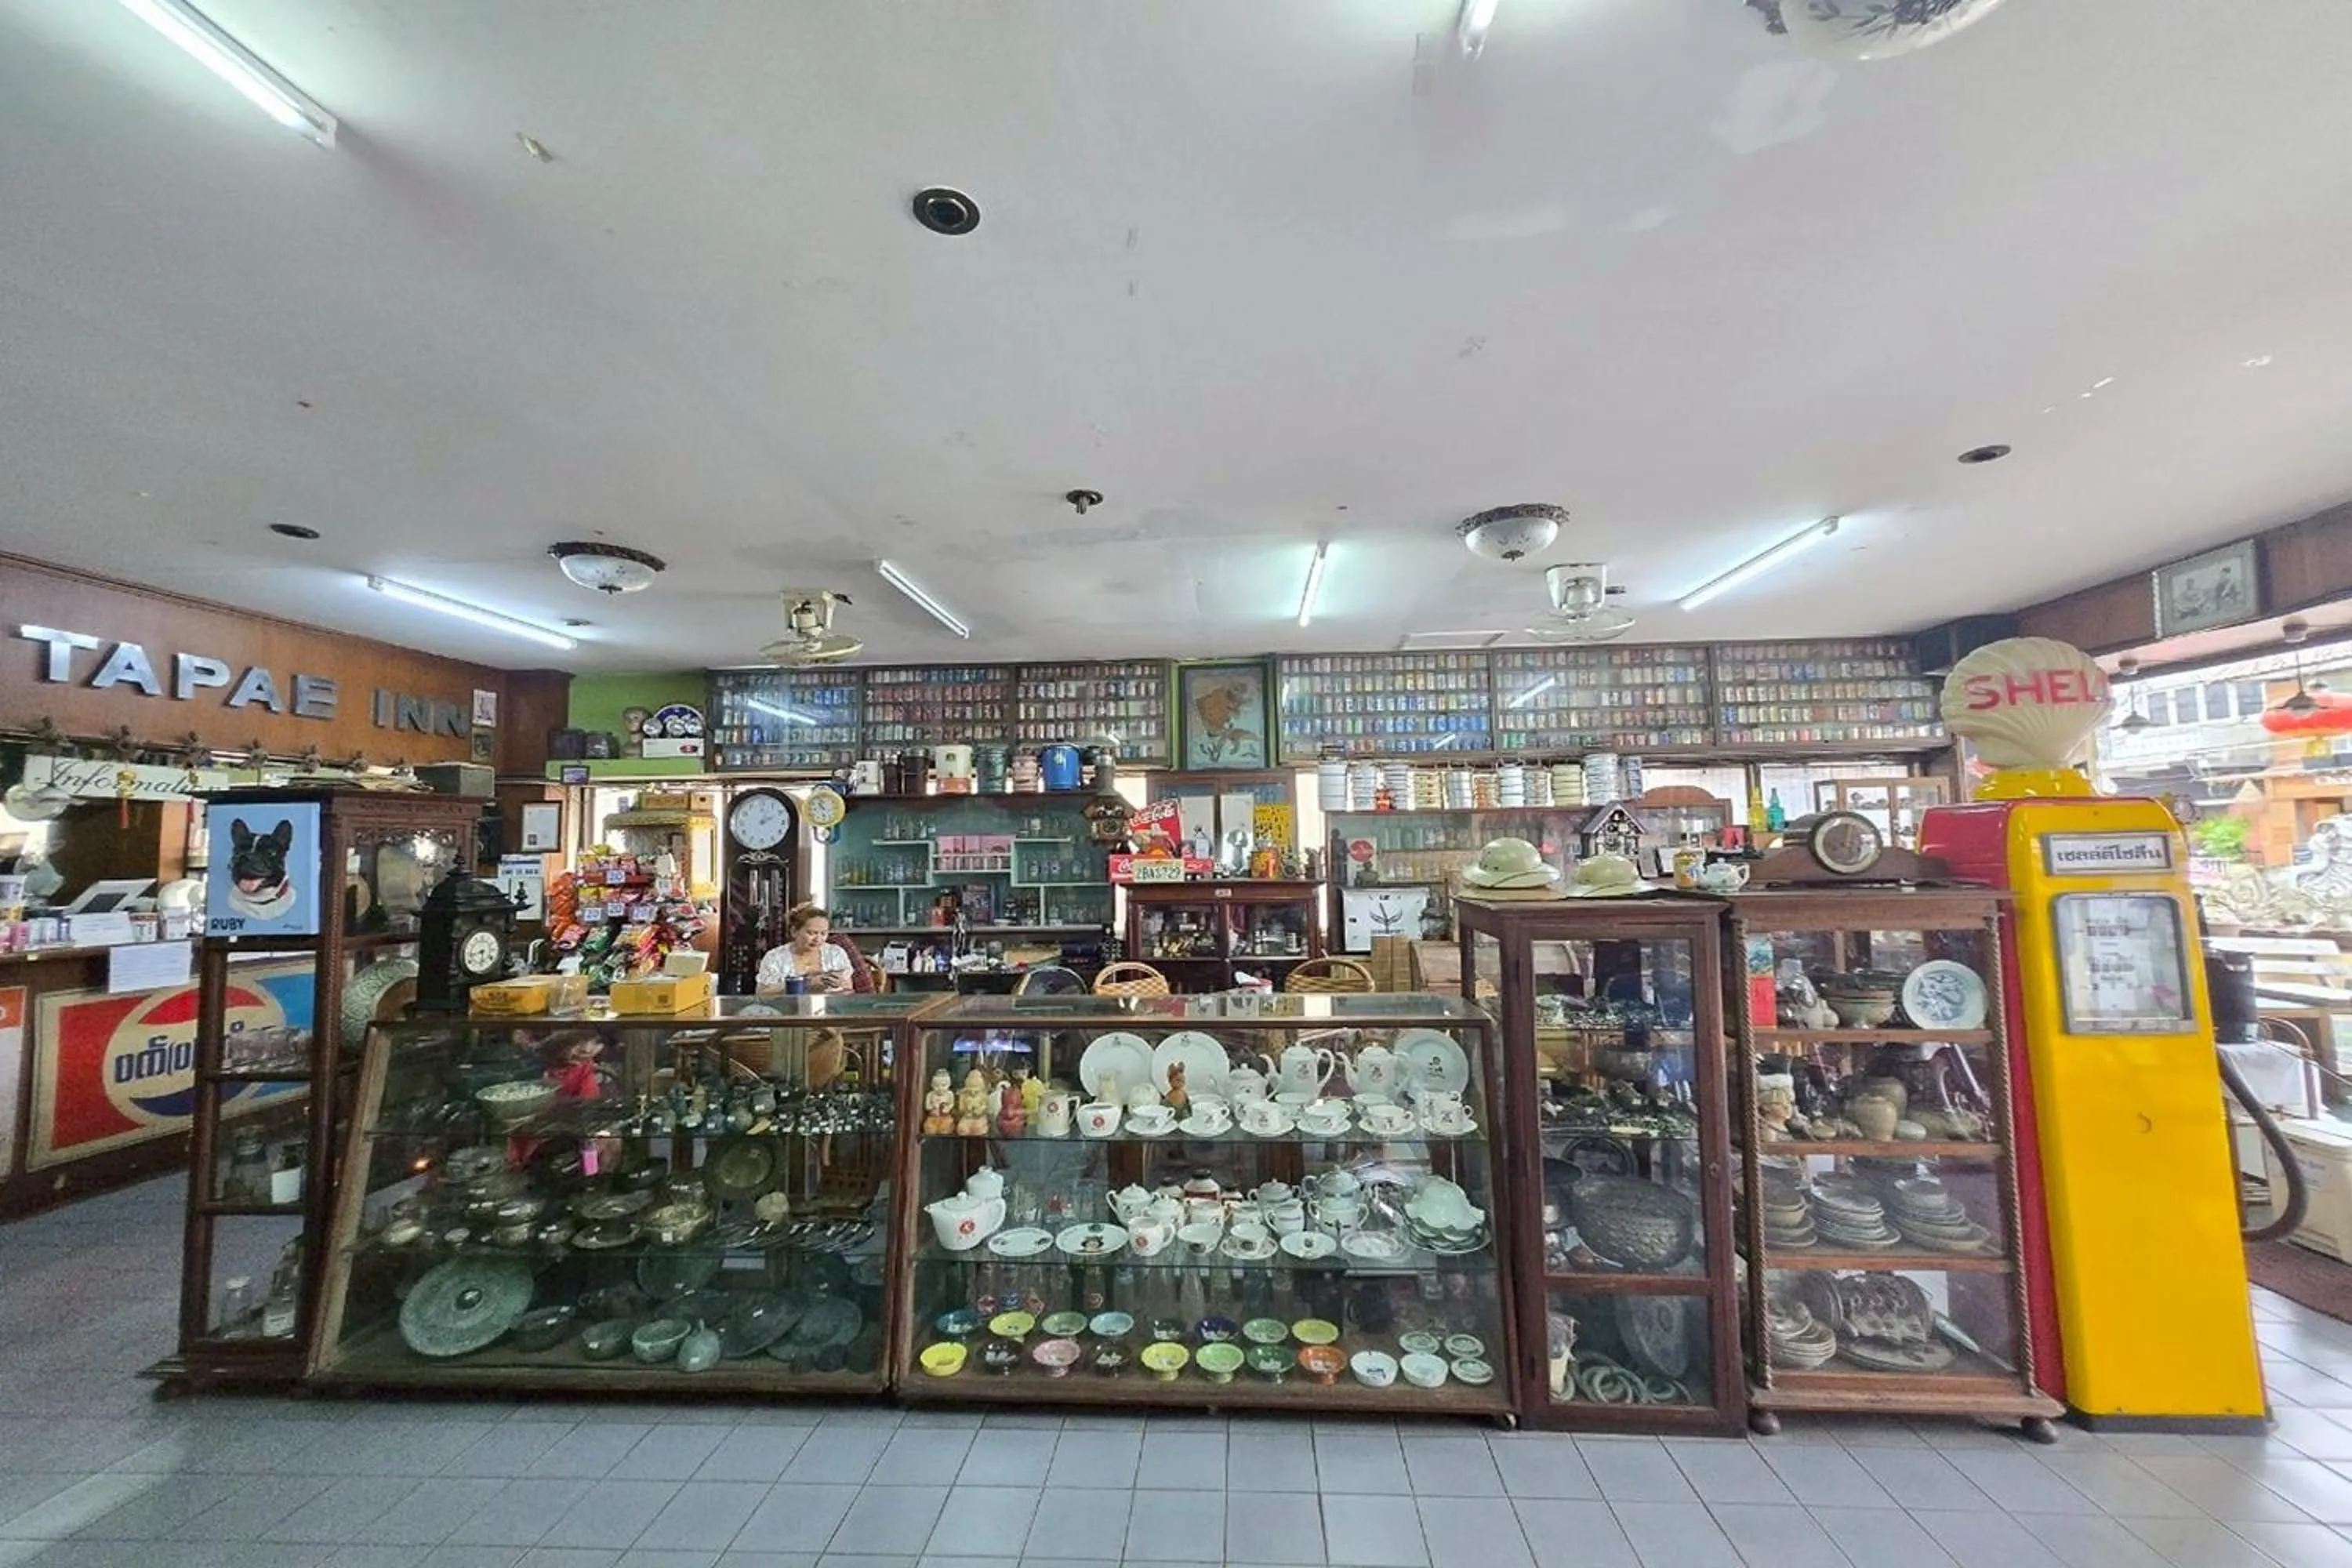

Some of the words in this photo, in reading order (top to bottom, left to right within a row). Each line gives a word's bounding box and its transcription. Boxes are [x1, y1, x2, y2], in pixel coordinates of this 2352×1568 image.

[20, 625, 337, 719] TAPAE
[374, 688, 469, 739] INN
[210, 916, 245, 931] RUBY
